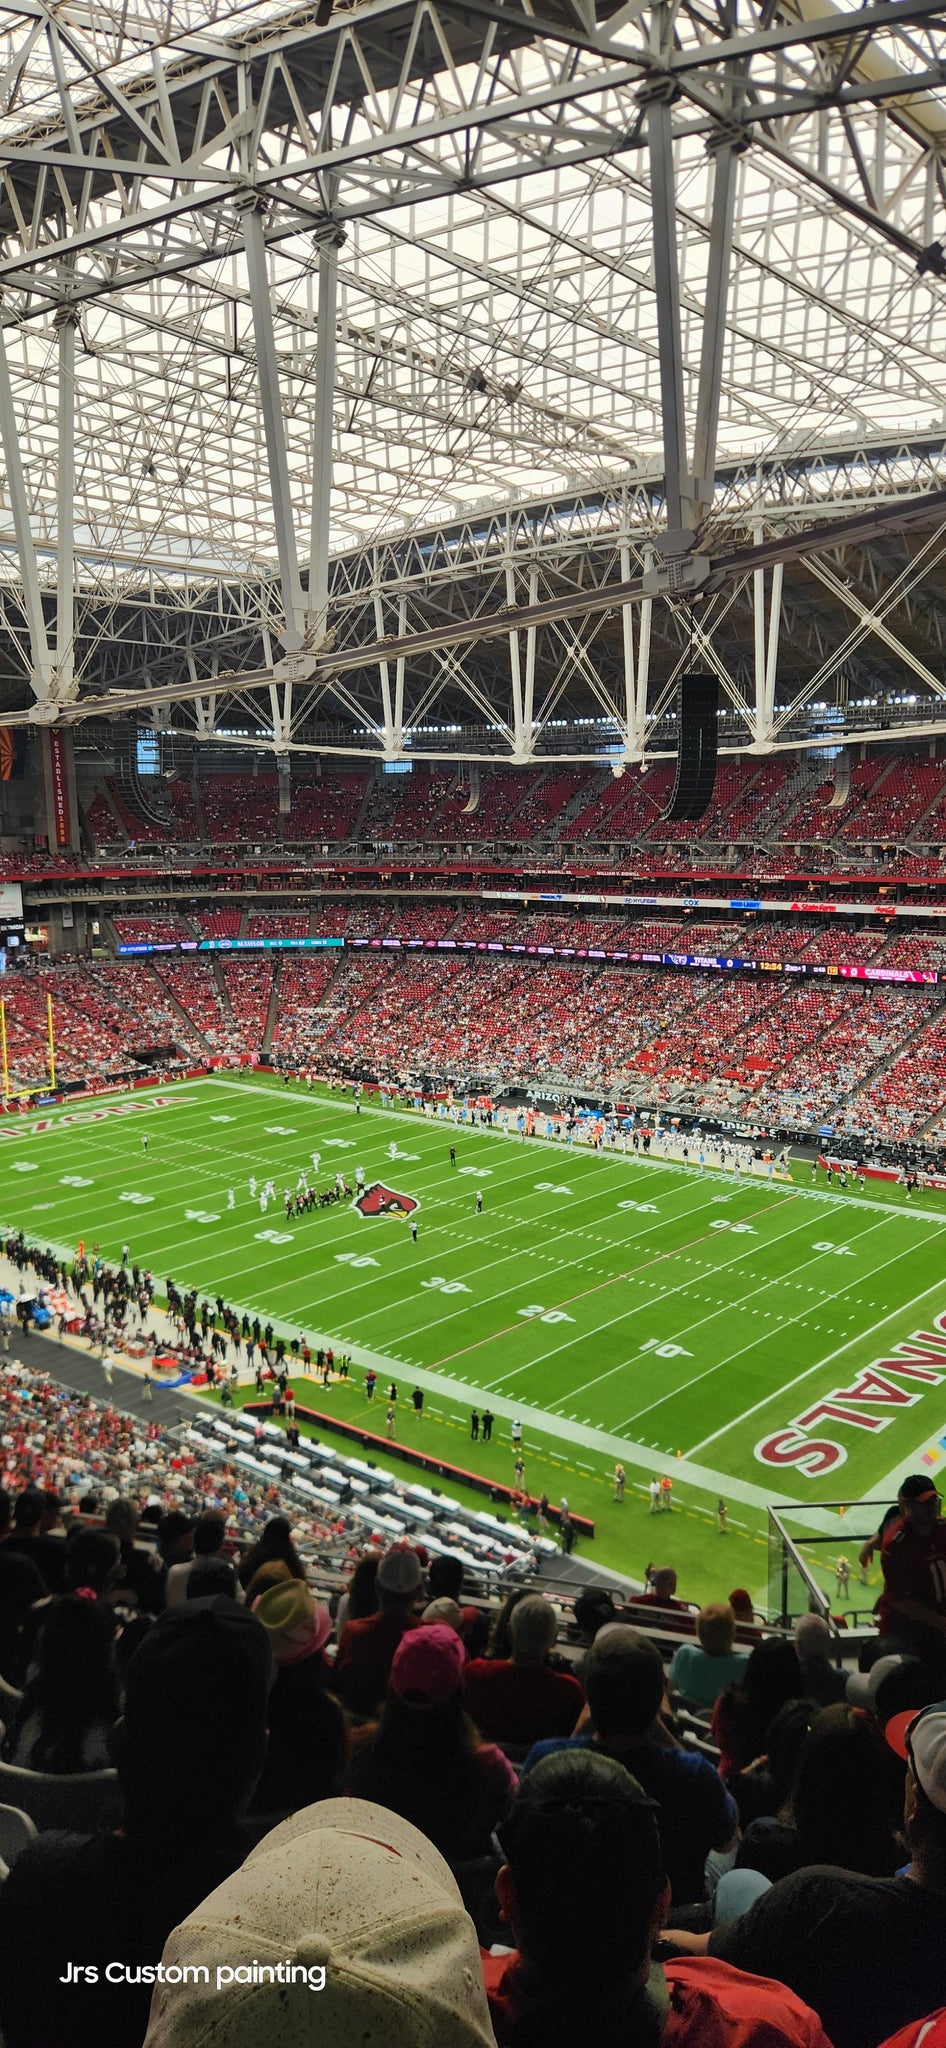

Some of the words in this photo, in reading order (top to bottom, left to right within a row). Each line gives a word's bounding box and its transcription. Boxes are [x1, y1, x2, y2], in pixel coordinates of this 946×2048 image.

[54, 741, 64, 815] ESTABLISHED
[801, 903, 818, 911] State
[819, 904, 836, 912] Farm
[693, 956, 717, 964] TITANS
[726, 959, 733, 967] 0
[760, 961, 782, 970] 12:54
[850, 968, 858, 976] 0
[865, 968, 908, 978] CARDINALS
[526, 1090, 577, 1105] ARIZOA
[699, 1117, 779, 1138] CRDIAS
[671, 1166, 768, 1187] INTRCPT
[774, 1185, 852, 1202] CANCER
[254, 1229, 295, 1244] 50
[333, 1252, 377, 1267] 40
[420, 1276, 467, 1293] 30
[516, 1304, 568, 1323] 20
[638, 1338, 684, 1358] 10
[754, 1310, 946, 1479] INALS
